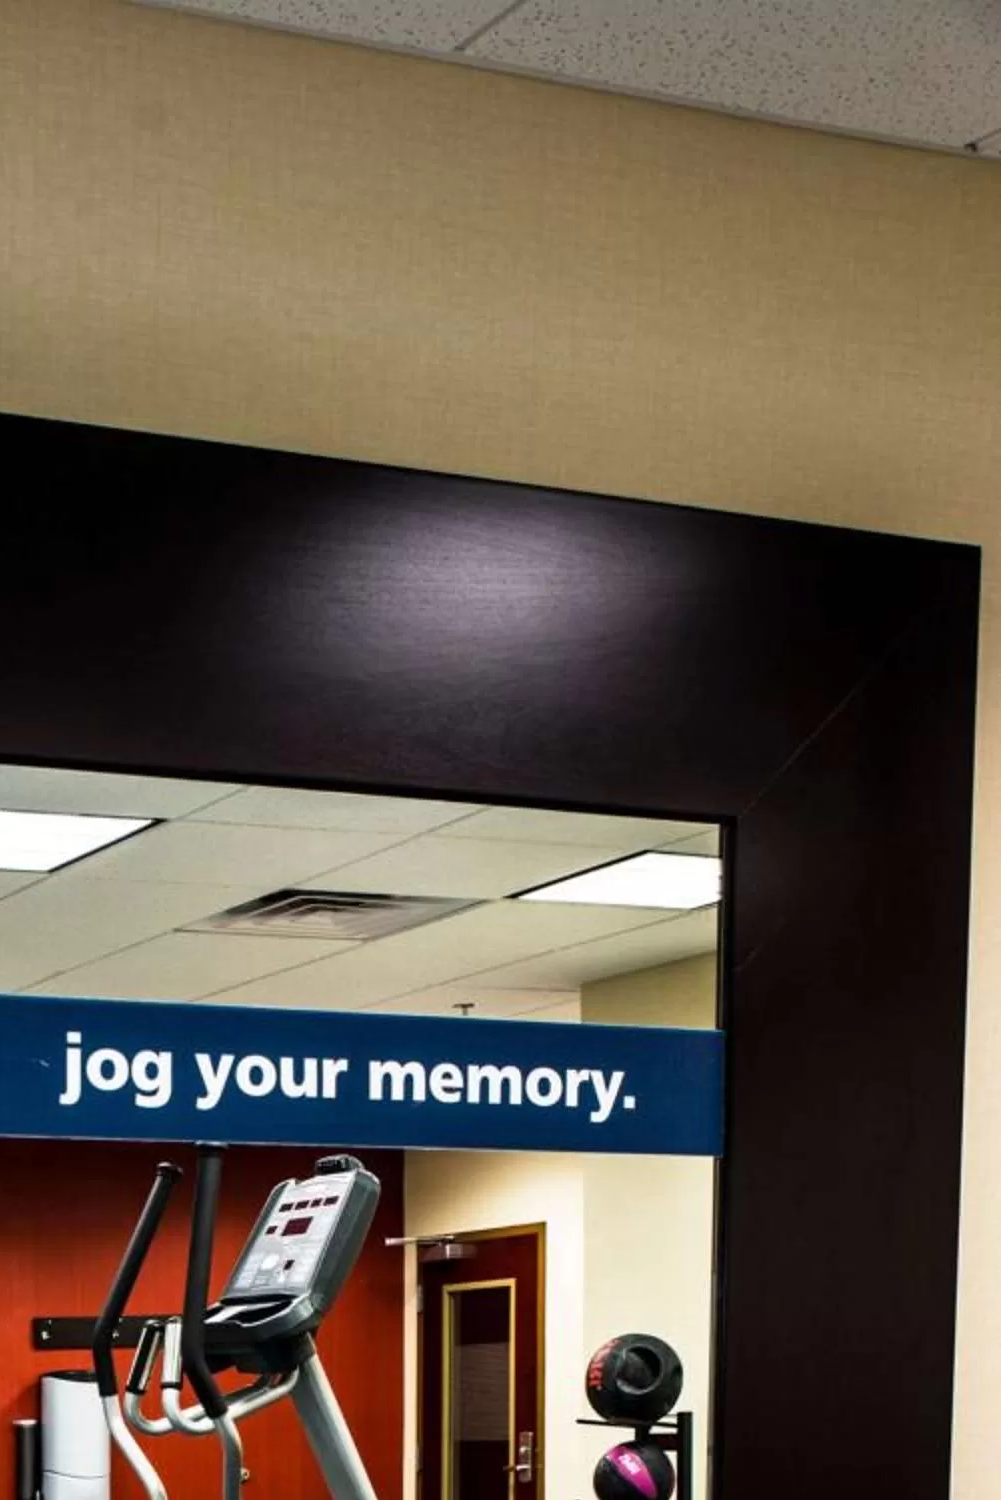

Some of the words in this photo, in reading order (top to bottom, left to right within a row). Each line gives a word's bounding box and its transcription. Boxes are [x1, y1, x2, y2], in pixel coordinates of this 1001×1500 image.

[59, 1031, 172, 1108] jog
[195, 1053, 348, 1111] your
[369, 1060, 636, 1123] memory.
